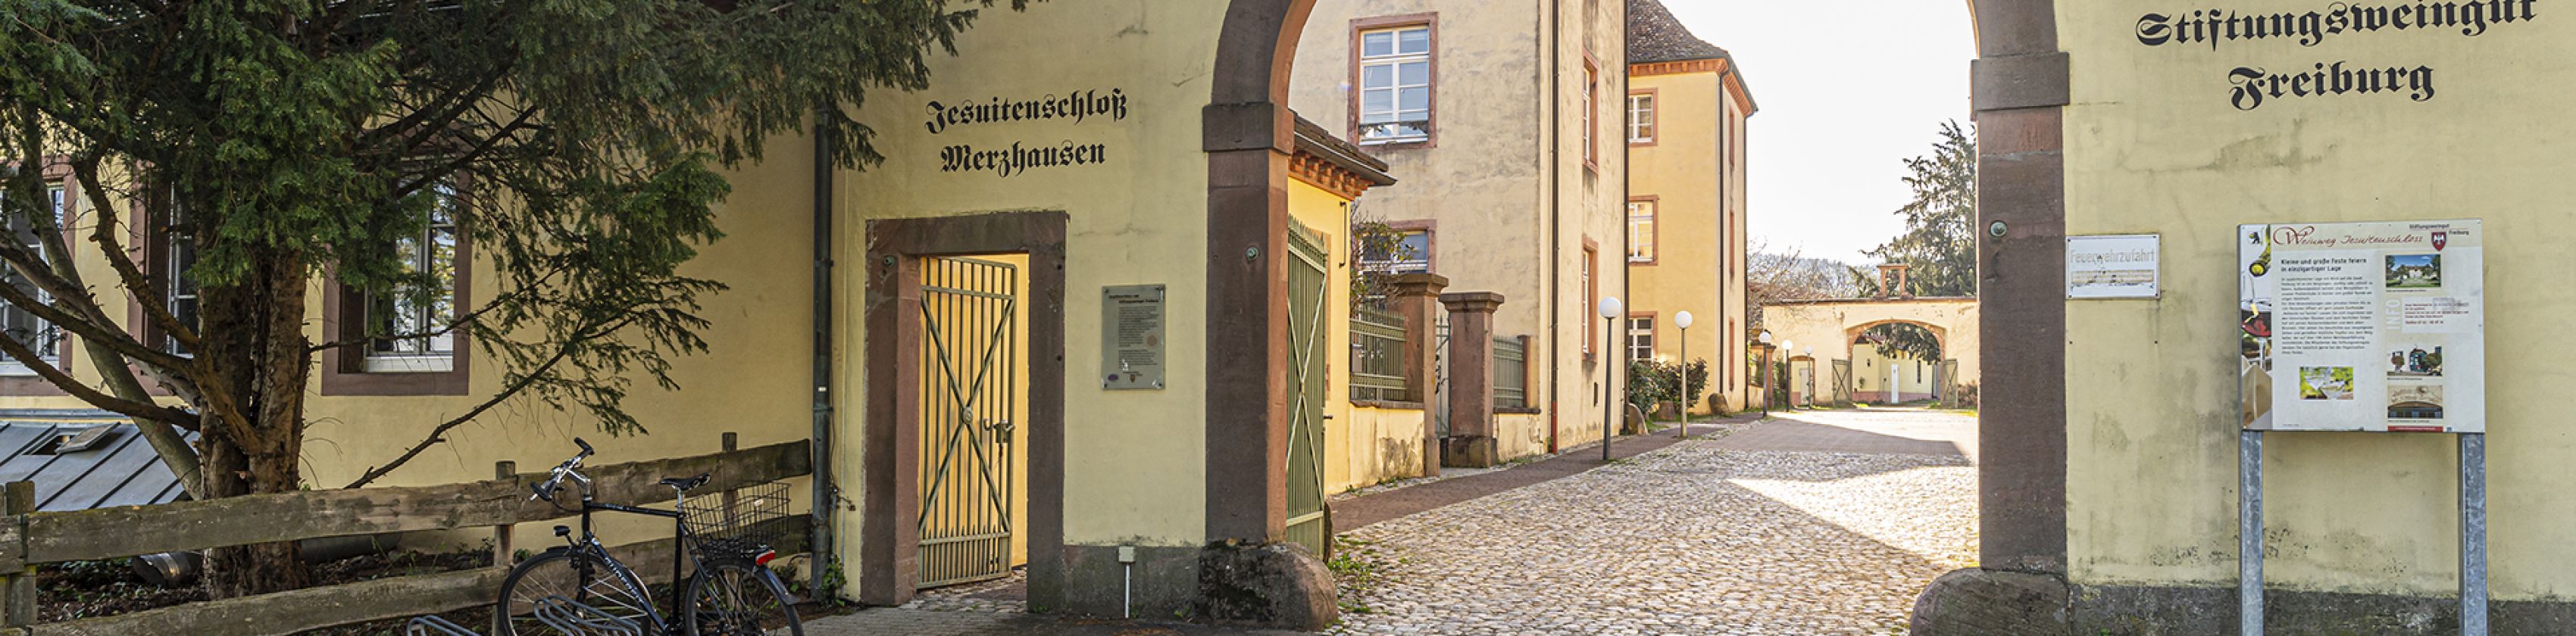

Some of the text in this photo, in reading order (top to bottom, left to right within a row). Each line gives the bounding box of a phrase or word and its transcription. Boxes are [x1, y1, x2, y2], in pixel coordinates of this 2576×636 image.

[2135, 0, 2537, 52] Stiftungsweingut
[2228, 60, 2434, 111] Freiburg
[924, 88, 1127, 135] Jesuitenschloß
[940, 139, 1105, 178] Merzhausen
[2071, 248, 2155, 265] Feuerwehrzufahrt
[2386, 300, 2402, 329] INFO
